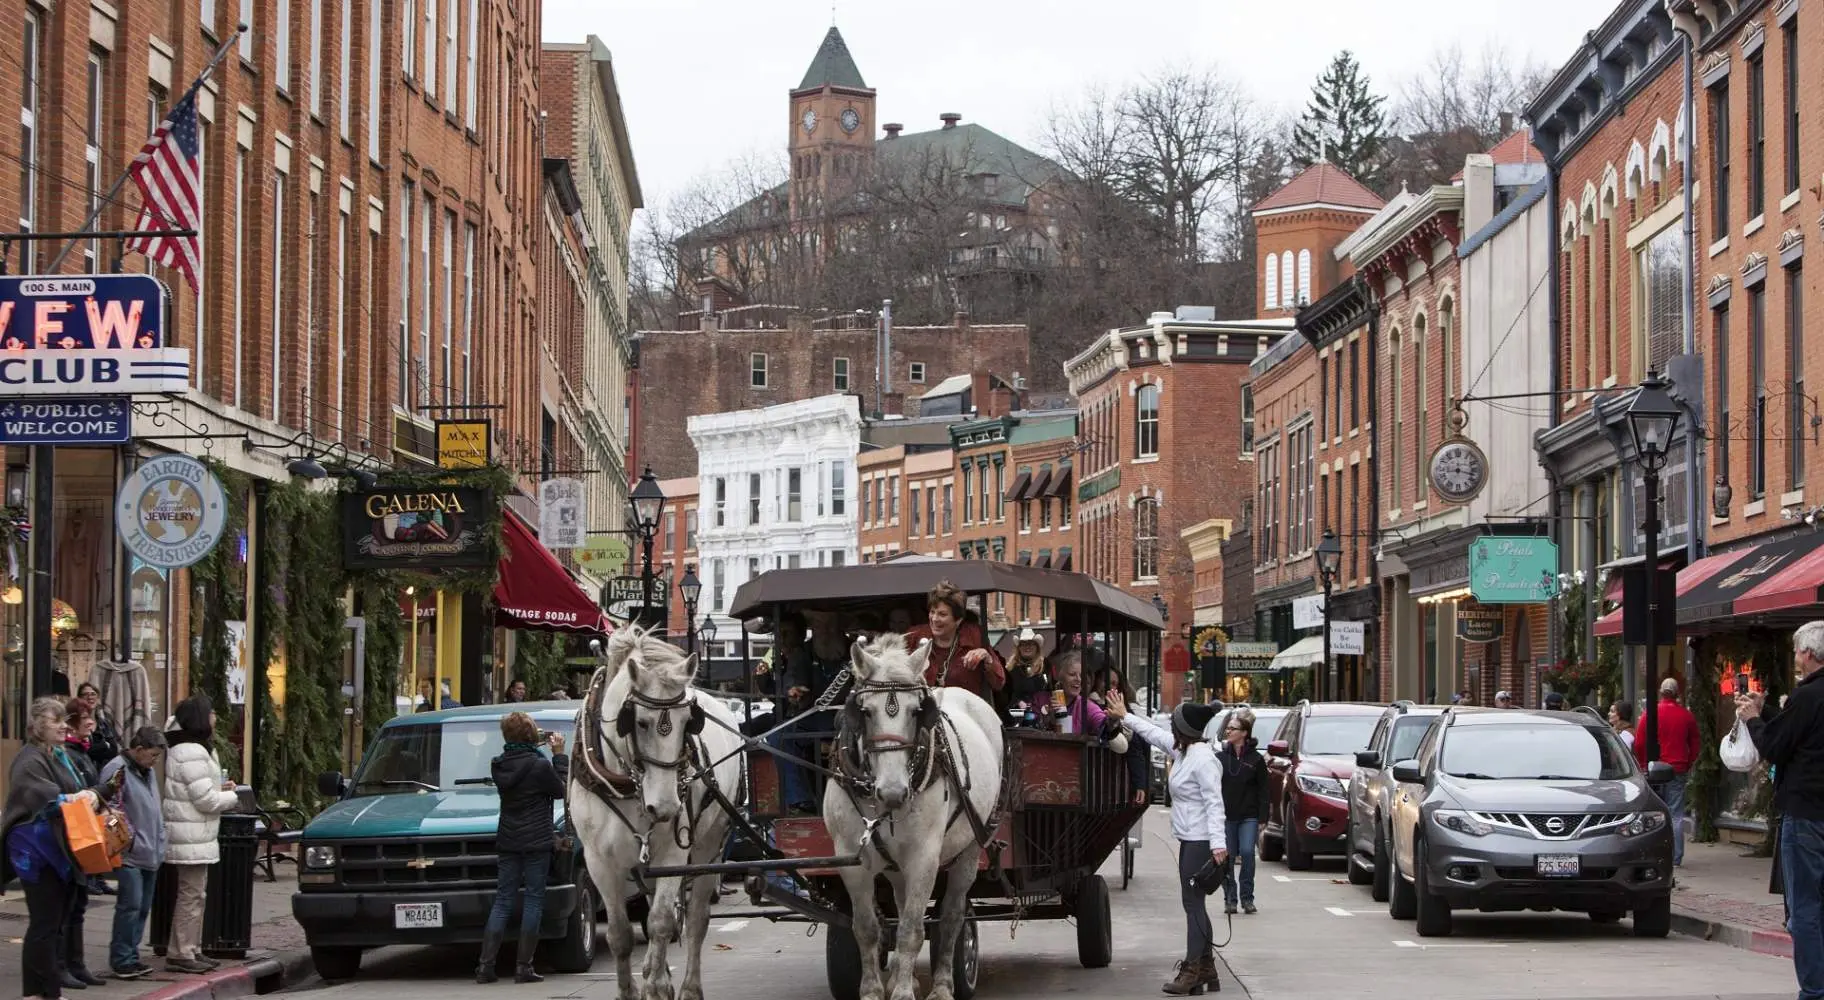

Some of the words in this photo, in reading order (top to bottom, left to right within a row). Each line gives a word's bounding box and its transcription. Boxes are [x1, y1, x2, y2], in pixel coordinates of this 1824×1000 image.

[25, 284, 44, 292] 100
[47, 283, 58, 292] S.
[61, 282, 91, 292] MAIN
[0, 358, 120, 384] CLUB
[20, 404, 103, 418] PUBLIC
[5, 421, 118, 435] WELCOME
[446, 432, 480, 441] MAX
[141, 460, 205, 483] EARTH'S
[365, 491, 466, 519] GALENA
[144, 511, 196, 521] JEWELRY
[127, 527, 213, 563] TREASURES
[1495, 541, 1533, 557] Petals
[616, 590, 664, 601] Maret
[501, 608, 540, 619] NTAGE
[544, 611, 577, 622] SODAS
[1458, 611, 1502, 619] HERITAGE
